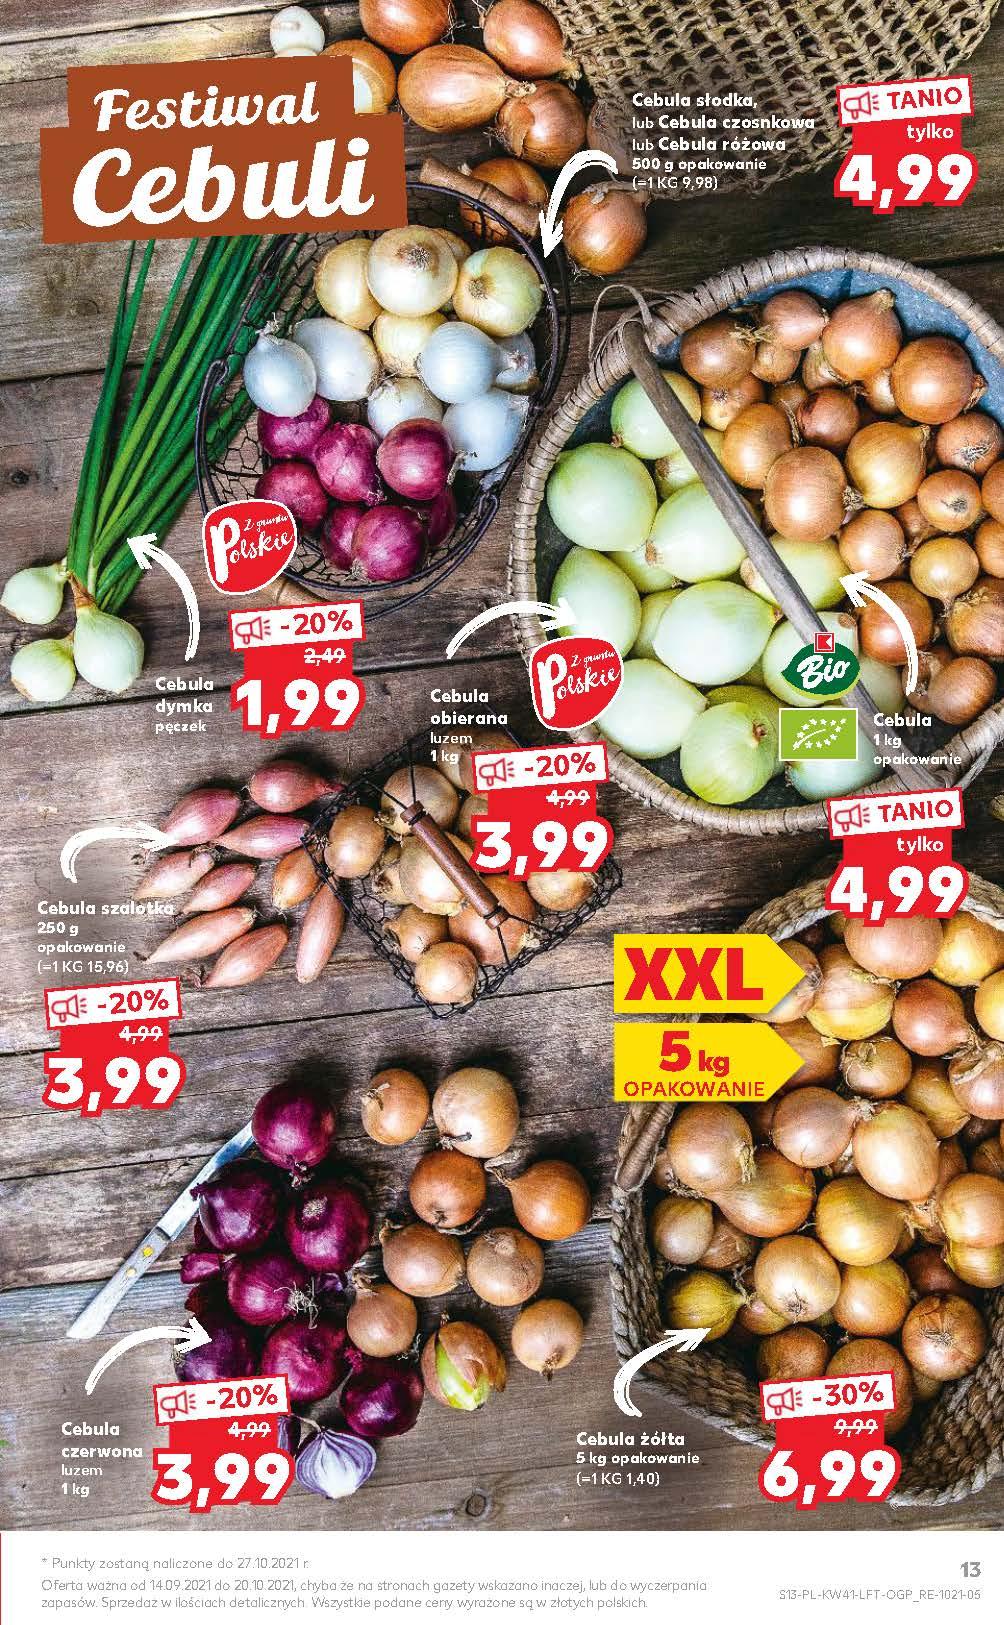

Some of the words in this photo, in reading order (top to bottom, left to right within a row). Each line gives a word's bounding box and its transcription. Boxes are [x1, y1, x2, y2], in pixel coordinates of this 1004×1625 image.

[632, 93, 691, 107] Cebula
[696, 93, 758, 109] słodka,
[887, 86, 962, 110] TANIO
[93, 81, 320, 132] Festiwal
[632, 116, 653, 129] lub
[658, 116, 717, 129] Cebula
[722, 116, 815, 129] czosnkowa
[906, 123, 954, 142] tylko
[632, 138, 653, 151] lub
[658, 138, 717, 151] Cebula
[722, 136, 786, 151] różowa
[632, 159, 660, 170] 500
[664, 161, 674, 174] g
[678, 159, 767, 174] opakowanie
[72, 137, 375, 228] Cebuli
[657, 177, 678, 189] KG
[682, 177, 718, 190] 9,98)
[839, 153, 974, 209] 4,99
[210, 517, 293, 584] Polskie
[280, 610, 353, 635] -20%
[304, 648, 346, 666] 2,49
[797, 655, 850, 689] Bio
[156, 677, 214, 691] Cebula
[537, 653, 620, 720] Polskie
[431, 689, 489, 703] Cebula
[156, 699, 213, 716] dymka
[236, 679, 360, 733] 1,99
[431, 711, 508, 725] obierana
[873, 713, 932, 727] Cebula
[156, 720, 207, 734] pęczek
[431, 732, 473, 744] luzem
[873, 735, 880, 746] 1
[885, 734, 901, 749] kg
[431, 750, 438, 762] 1
[442, 750, 459, 764] kg
[525, 752, 596, 777] -20%
[873, 755, 962, 768] opakowanie
[546, 790, 590, 808] 4,99
[878, 800, 953, 823] TANIO
[476, 821, 608, 875] 3,99
[897, 836, 943, 855] tylko
[831, 866, 964, 920] 4,99
[38, 901, 96, 915] Cebula
[101, 901, 174, 915] szalotka
[38, 922, 66, 934] 250
[70, 924, 79, 936] g
[38, 941, 126, 955] opakowanie
[62, 961, 83, 973] KG
[87, 960, 129, 974] 15,96)
[624, 948, 763, 1000] XXL
[98, 989, 170, 1014] -20%
[119, 1025, 163, 1044] 4,99
[659, 1031, 691, 1072] 5
[699, 1050, 729, 1077] kg
[48, 1057, 181, 1112] 3,99
[624, 1081, 765, 1097] OPAKOWANIE
[207, 1384, 278, 1409] -20%
[812, 1381, 884, 1406] -30%
[61, 1422, 120, 1436] Cebula
[228, 1421, 271, 1440] 4,99
[834, 1419, 879, 1438] 9,99
[576, 1432, 635, 1446] Cebula
[640, 1431, 685, 1446] żółta
[61, 1447, 143, 1458] czerwona
[576, 1452, 586, 1464] 5
[589, 1452, 607, 1467] kg
[611, 1452, 700, 1467] opakowanie
[61, 1464, 103, 1476] luzem
[763, 1449, 896, 1504] 6,99
[156, 1452, 290, 1508] 3,99
[601, 1473, 622, 1484] KG
[626, 1472, 660, 1486] 1,40)
[61, 1483, 68, 1495] 1
[72, 1483, 90, 1497] kg
[52, 1557, 96, 1573] Punkty
[99, 1557, 150, 1572] zostaną
[153, 1557, 213, 1569] naliczone
[217, 1557, 233, 1569] do
[237, 1557, 299, 1569] 27.10.2021
[960, 1562, 981, 1577] 13
[41, 1579, 83, 1591] Oferta
[87, 1579, 127, 1591] ważna
[130, 1579, 146, 1591] od
[150, 1579, 211, 1591] 14.09.2021
[214, 1579, 231, 1591] do
[234, 1579, 297, 1592] 20.10.2021,
[300, 1579, 337, 1593] chyba
[339, 1580, 354, 1591] że
[358, 1582, 373, 1591] na
[377, 1579, 430, 1591] stronach
[433, 1580, 475, 1593] gazety
[478, 1579, 538, 1591] wskazano
[541, 1580, 586, 1593] inaczej,
[589, 1579, 607, 1591] lub
[610, 1579, 627, 1591] do
[630, 1580, 707, 1593] wyczerpania
[41, 1596, 98, 1611] zapasów.
[101, 1596, 158, 1611] Sprzedaż
[161, 1599, 171, 1608] w
[175, 1596, 226, 1608] ilościach
[311, 1596, 371, 1611] Wszystkie
[374, 1596, 422, 1611] podane
[425, 1599, 453, 1611] ceny
[457, 1597, 516, 1611] wyrażone
[519, 1599, 533, 1611] są
[536, 1599, 547, 1608] w
[550, 1596, 594, 1611] złotych
[597, 1596, 648, 1611] polskich.
